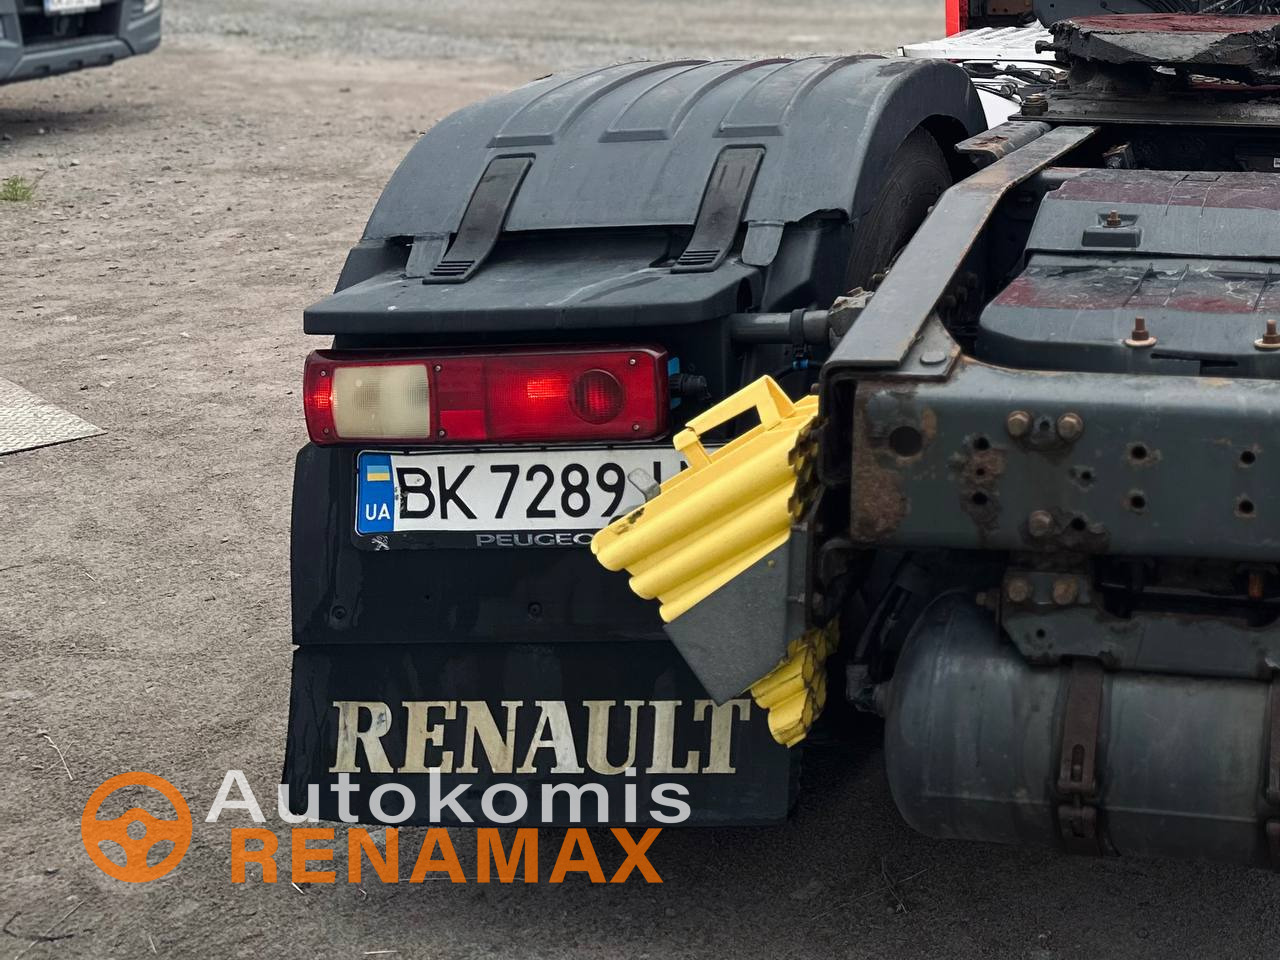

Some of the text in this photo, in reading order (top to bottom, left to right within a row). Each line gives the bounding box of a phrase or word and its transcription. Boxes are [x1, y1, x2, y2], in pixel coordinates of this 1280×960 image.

[396, 465, 478, 520] BK
[490, 462, 626, 519] 7289
[365, 503, 391, 520] UA
[476, 533, 597, 547] PEUGEO
[328, 700, 751, 776] RENAULT
